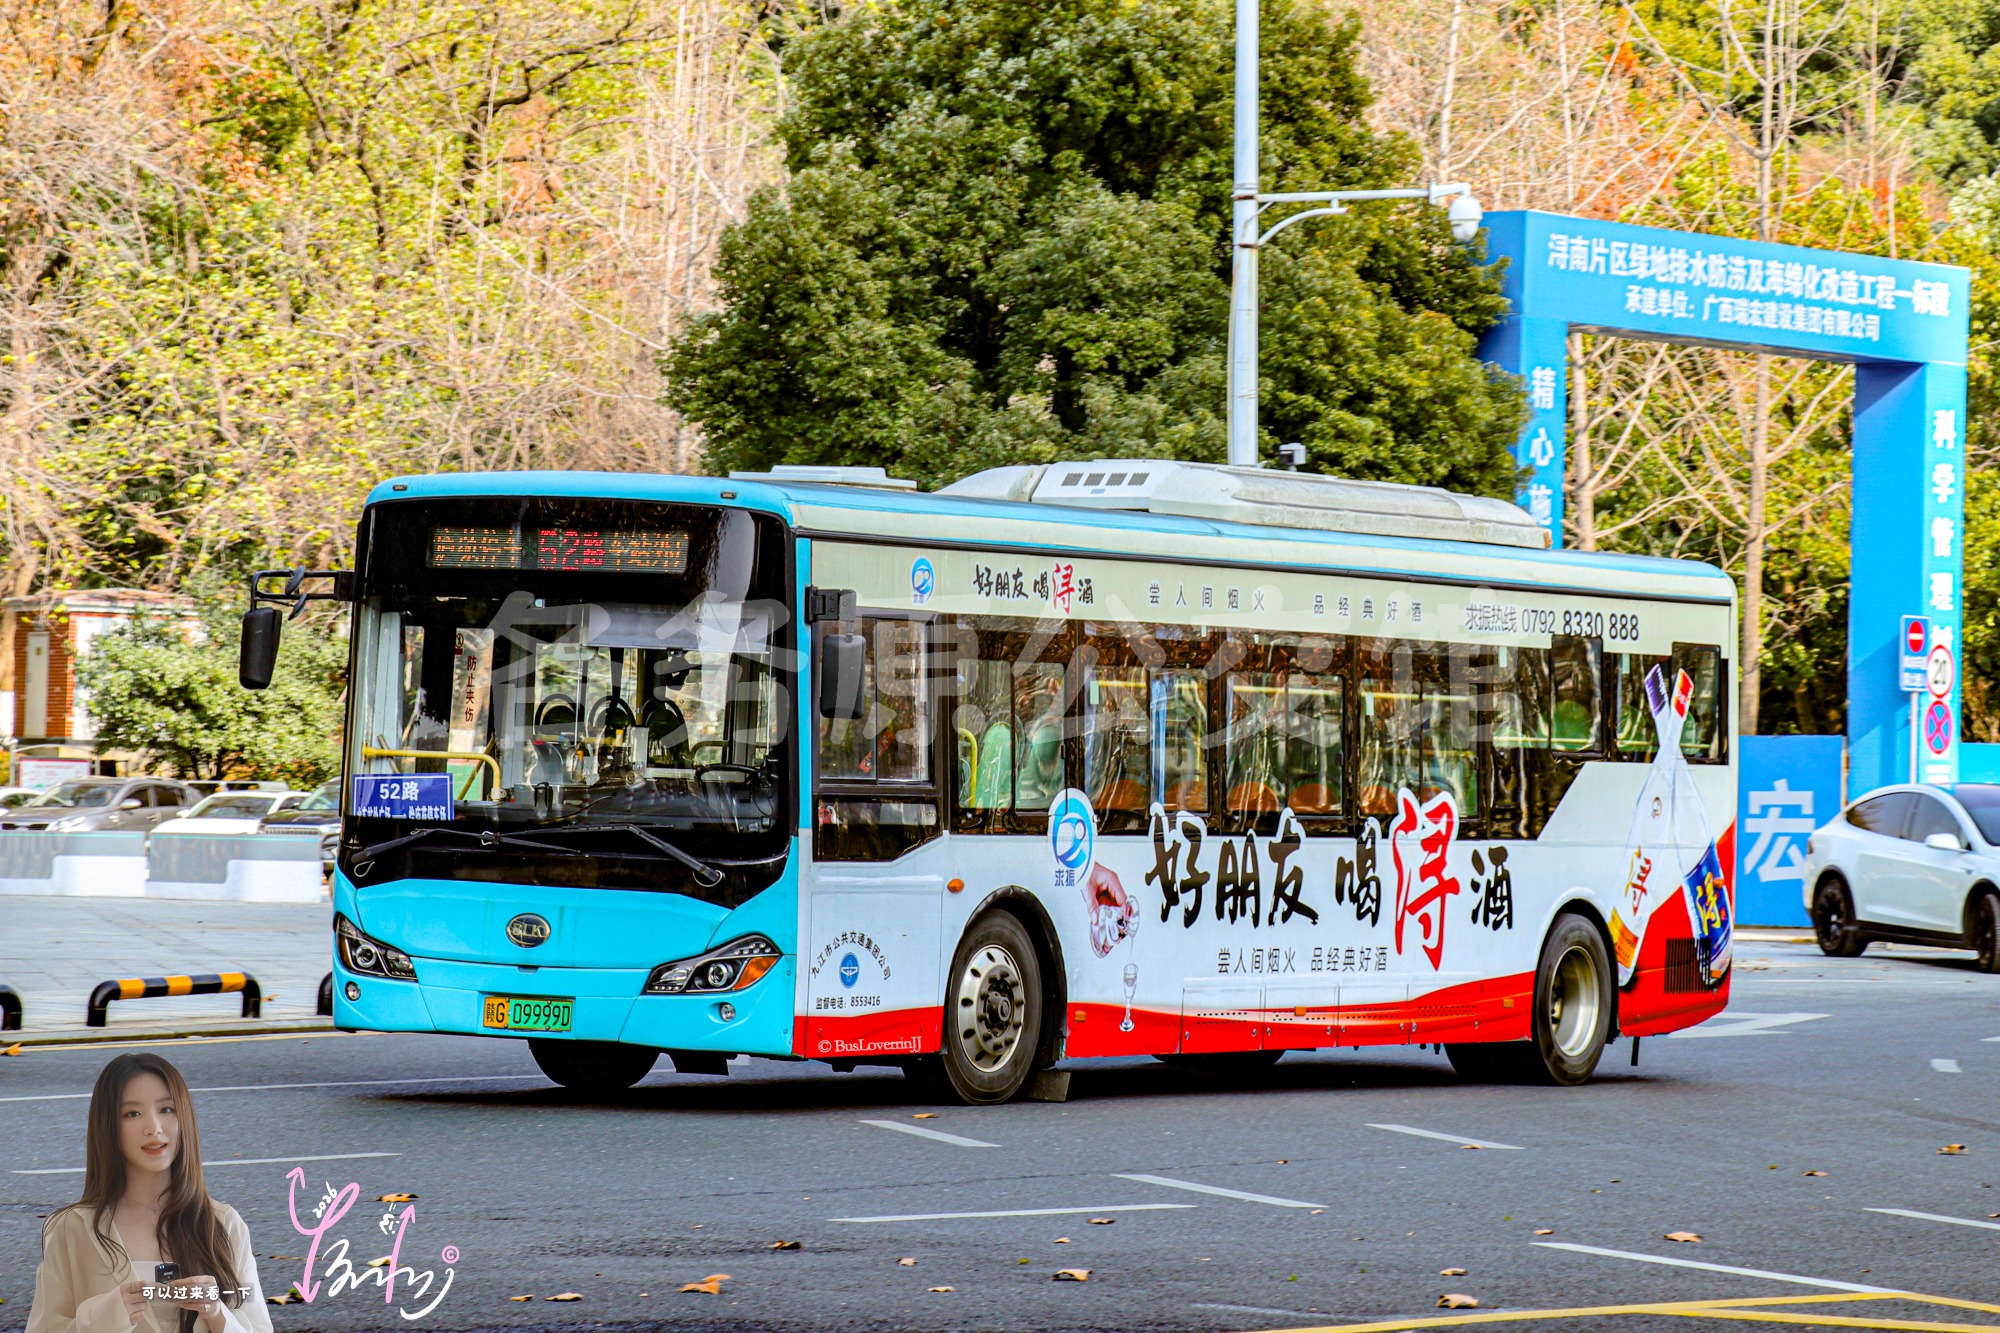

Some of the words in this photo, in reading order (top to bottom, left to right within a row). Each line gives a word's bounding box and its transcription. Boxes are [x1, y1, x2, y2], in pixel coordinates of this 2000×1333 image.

[1148, 582, 1266, 613] 尝人间烟火
[1312, 594, 1424, 623] 品经典好酒
[1465, 603, 1518, 633] 求振热线
[1521, 608, 1556, 634] 0792
[1563, 610, 1604, 638] 8330
[1609, 613, 1640, 642] 888
[465, 655, 477, 722] 防止夹伤
[379, 781, 420, 801] 52路
[1744, 779, 1816, 883] 宏
[811, 931, 891, 980] 九江市公共交通集团公司
[1217, 947, 1297, 974] 尝人间烟火
[1311, 946, 1388, 972] 品经典好酒
[850, 996, 881, 1007] 8553416
